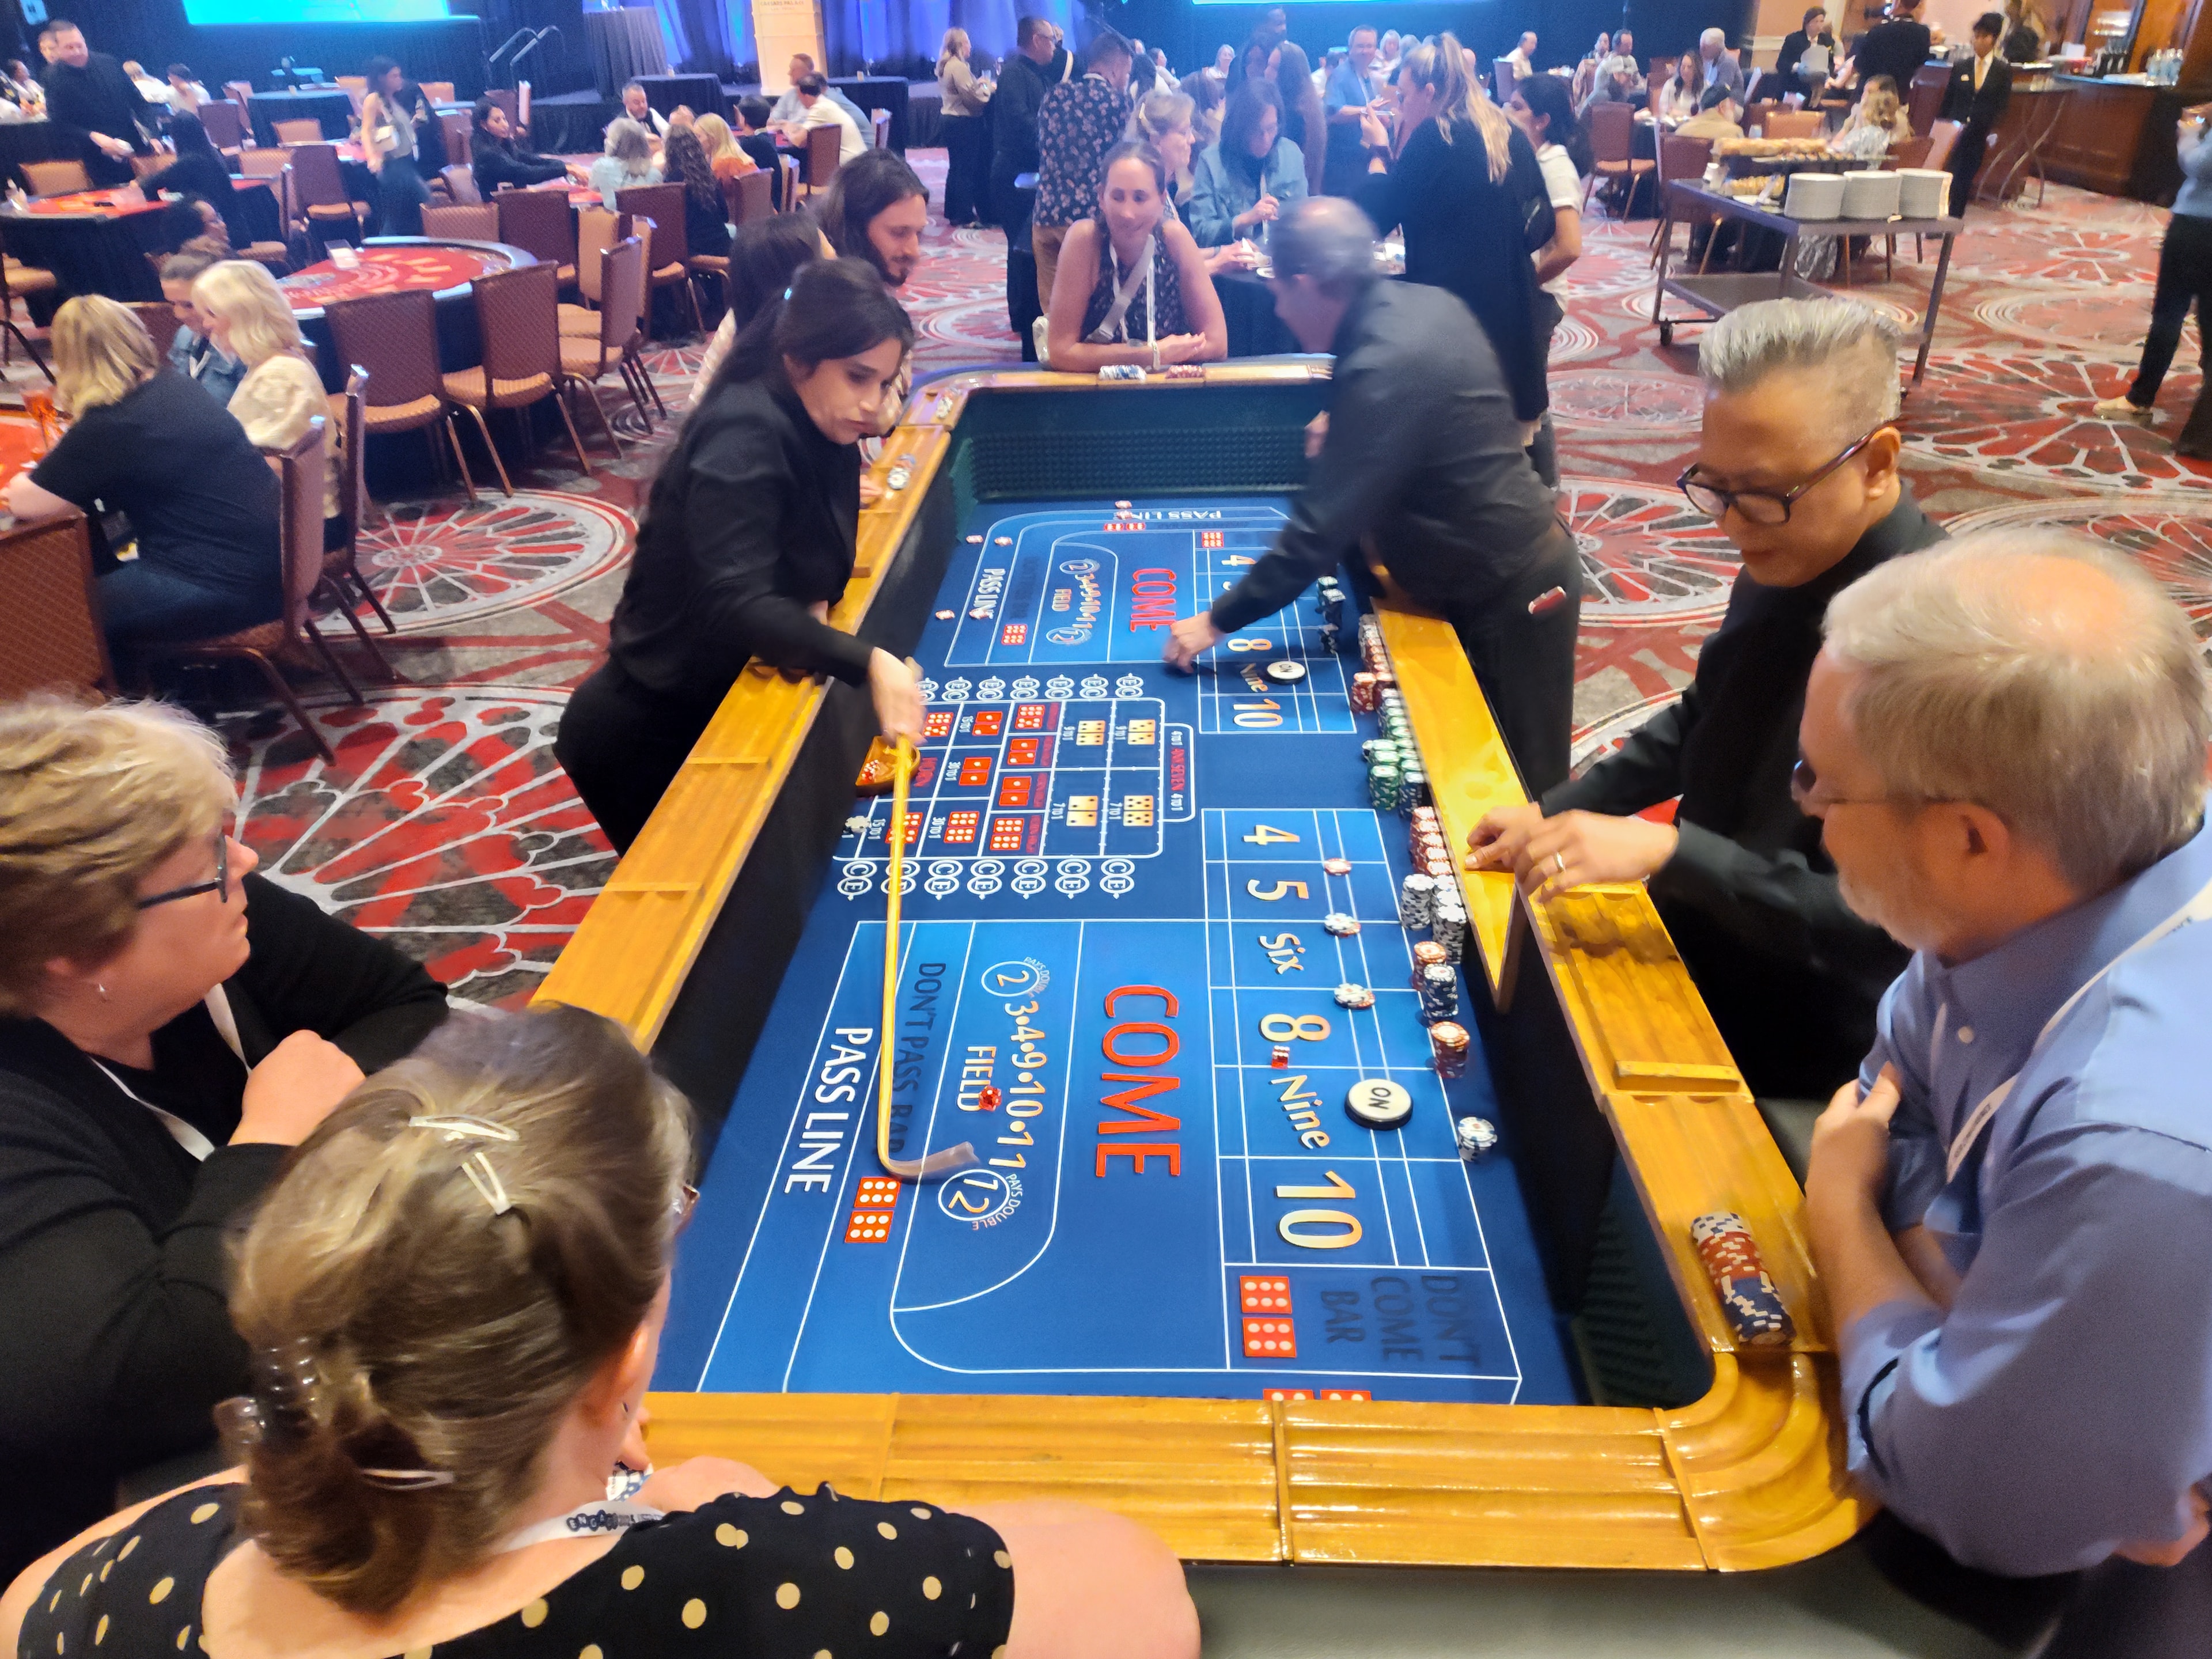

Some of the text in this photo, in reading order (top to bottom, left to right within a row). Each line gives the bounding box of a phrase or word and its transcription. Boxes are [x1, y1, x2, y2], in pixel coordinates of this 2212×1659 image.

[1168, 510, 1221, 520] PASS
[1068, 563, 1089, 571] 2
[1221, 554, 1257, 566] 4
[978, 568, 1006, 594] PASS
[1051, 588, 1072, 612] FIELD
[1130, 567, 1177, 632] COME
[1227, 638, 1272, 652] 8
[1278, 664, 1293, 673] ON
[1233, 698, 1283, 728] 10
[1243, 824, 1300, 846] 4
[844, 880, 864, 891] E
[931, 880, 951, 891] E
[974, 880, 994, 891] E
[1018, 879, 1038, 890] E
[1062, 879, 1082, 890] E
[1107, 879, 1126, 889] E
[1247, 879, 1309, 901] 5
[1023, 956, 1046, 970] PAYS
[1258, 933, 1306, 975] Six
[996, 969, 1030, 987] 2
[904, 963, 946, 1031] DON'T
[1258, 1013, 1331, 1042] 8
[893, 1036, 930, 1092] PASS
[957, 1046, 997, 1112] FIELD
[1096, 984, 1181, 1177] COME
[1368, 1086, 1391, 1110] ON
[784, 1028, 874, 1194] PASS LINE
[1268, 1074, 1331, 1149] Nine
[948, 1178, 999, 1214] 12
[971, 1173, 1024, 1231] PAYS DOUBLE
[1275, 1170, 1363, 1249] 10
[1320, 1290, 1365, 1343] BAR
[1370, 1276, 1425, 1362] COME
